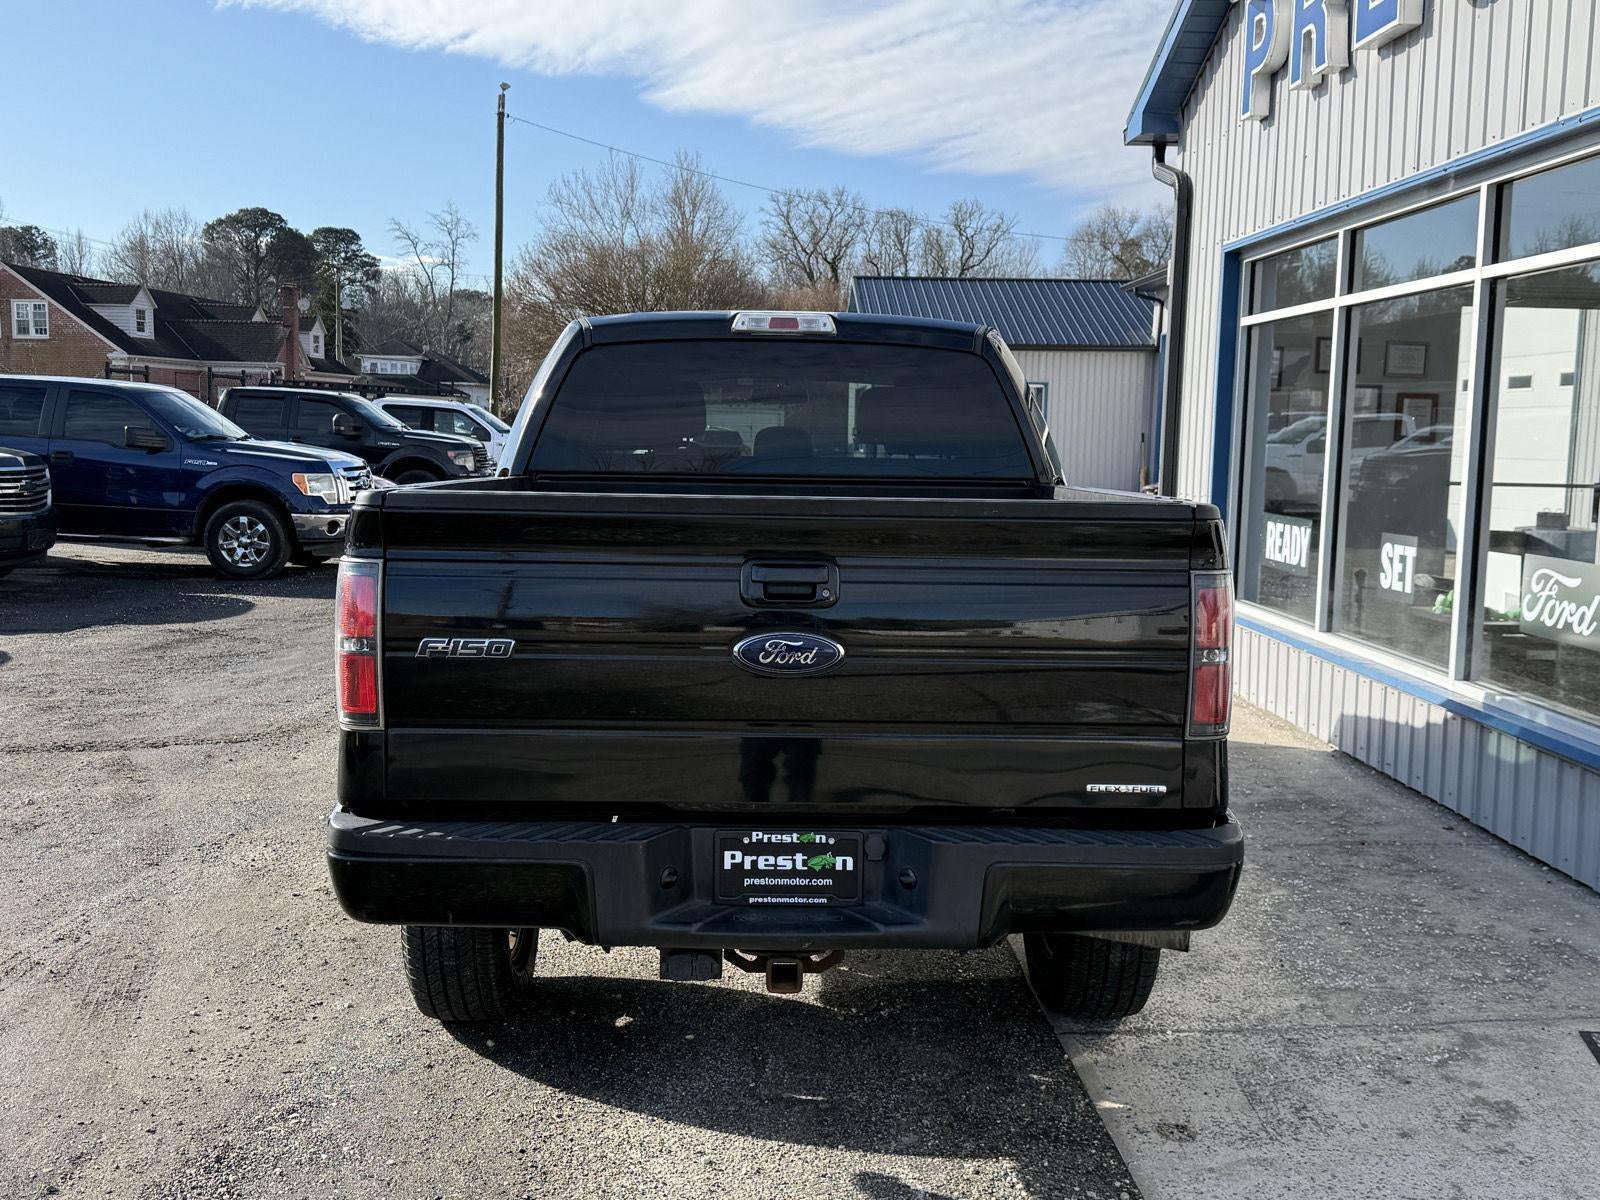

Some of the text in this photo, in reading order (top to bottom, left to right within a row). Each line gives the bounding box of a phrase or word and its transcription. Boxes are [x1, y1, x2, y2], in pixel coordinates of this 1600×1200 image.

[1264, 520, 1312, 568] READY
[1379, 542, 1417, 594] SET
[1522, 568, 1600, 636] Ford
[758, 639, 819, 665] Ford
[744, 877, 833, 887] prestonmotor.com
[749, 896, 827, 904] prestonmotor.com
